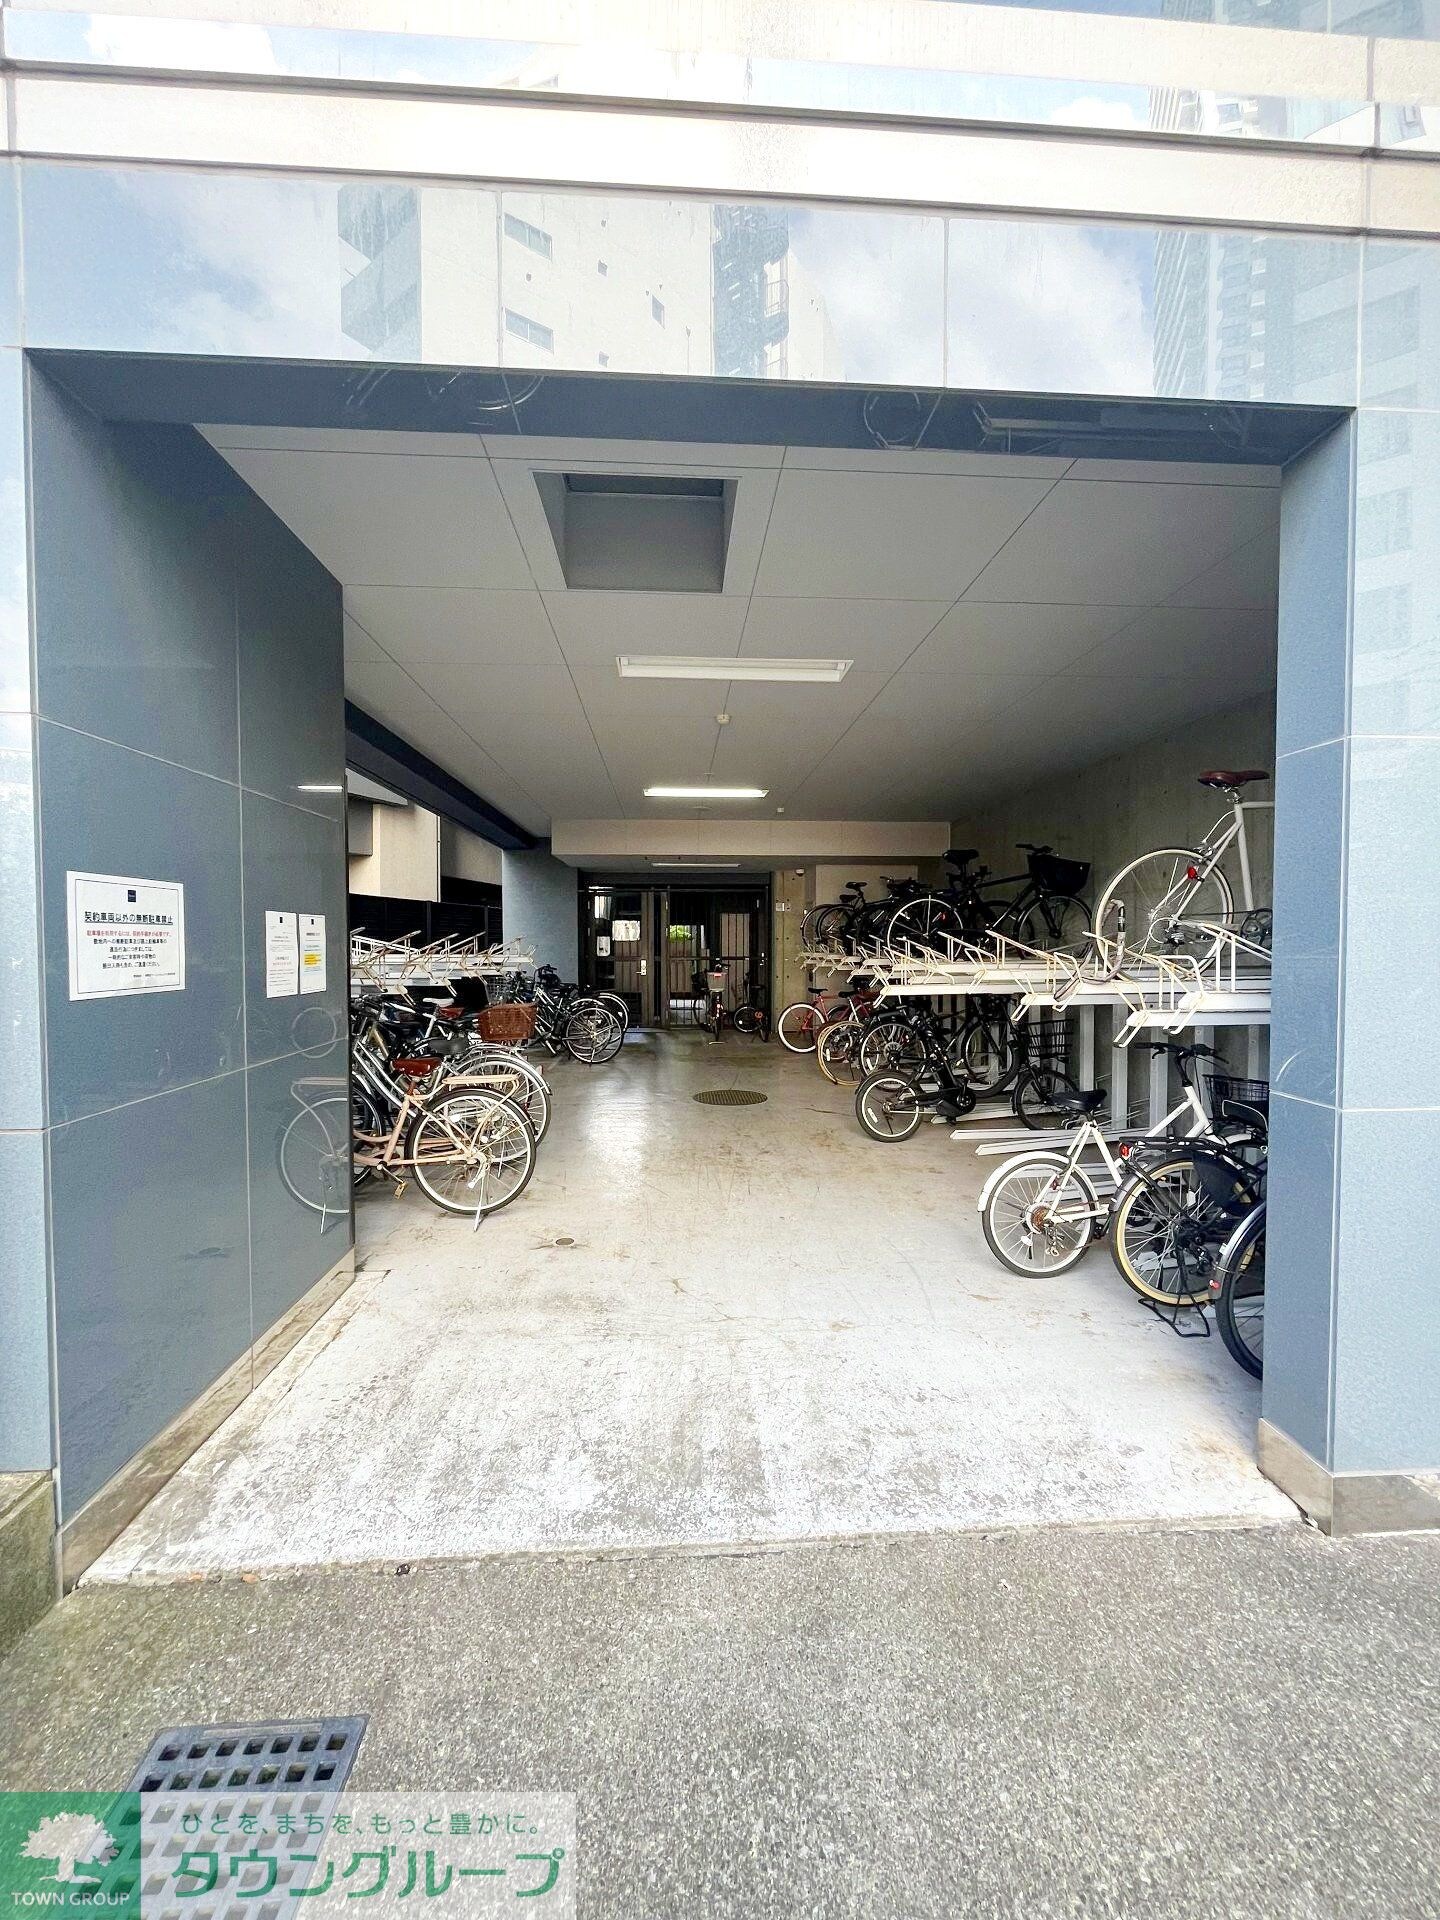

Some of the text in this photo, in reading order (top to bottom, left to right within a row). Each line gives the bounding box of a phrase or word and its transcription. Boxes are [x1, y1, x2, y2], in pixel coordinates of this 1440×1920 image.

[84, 911, 173, 924] 契約車両以外の無断駐車禁止
